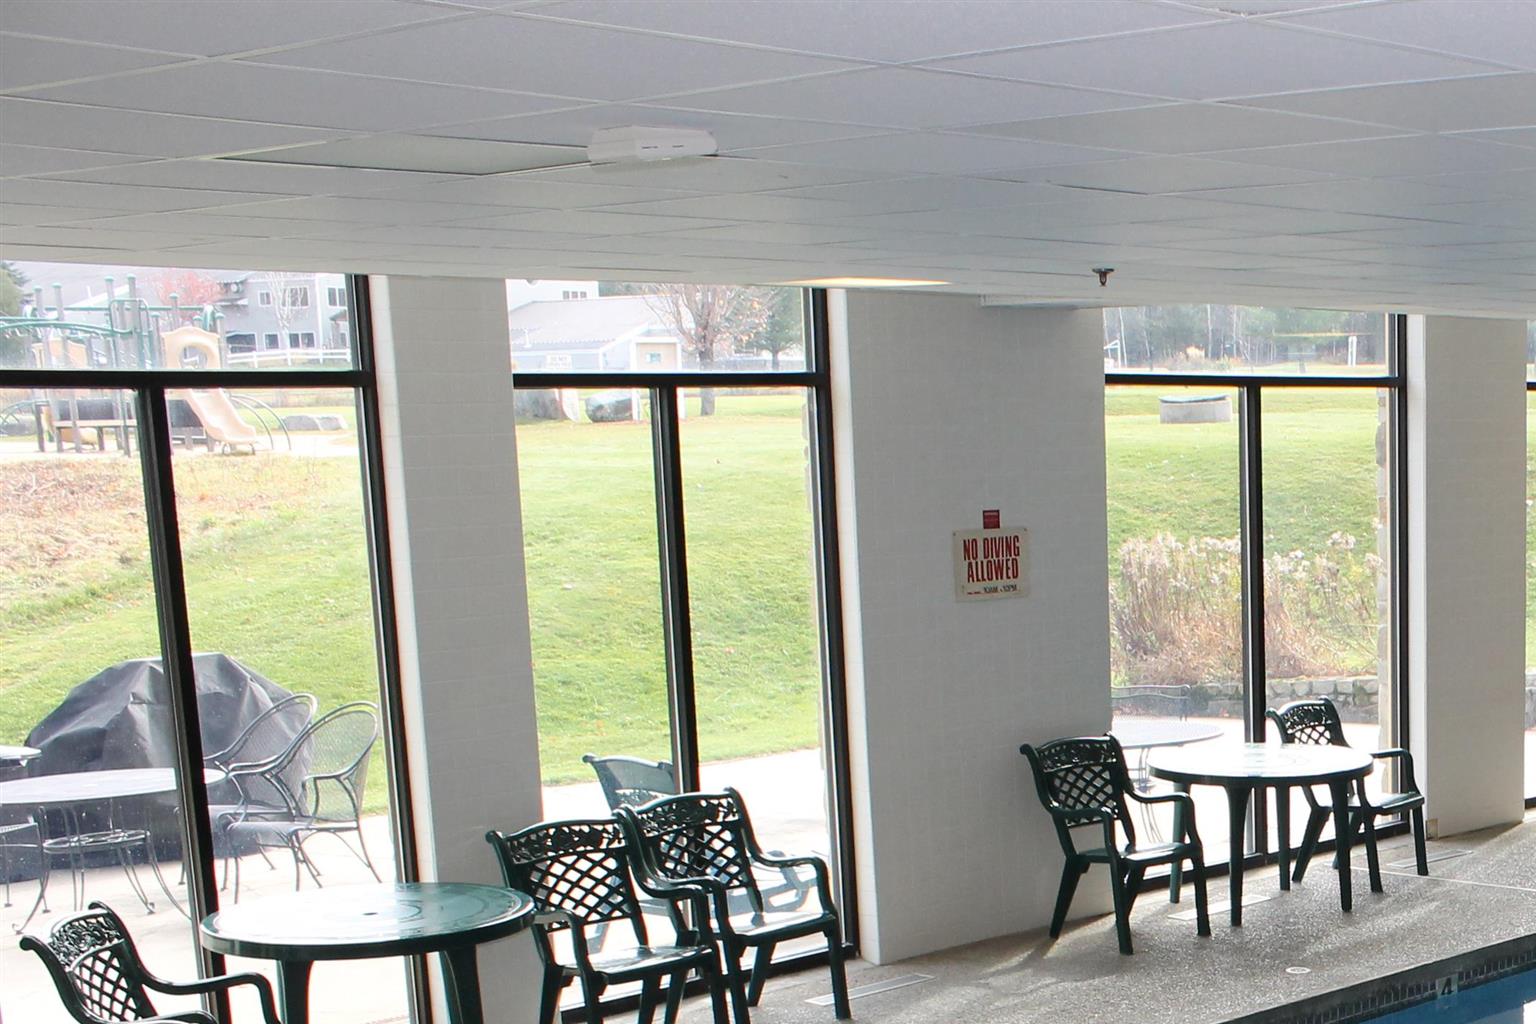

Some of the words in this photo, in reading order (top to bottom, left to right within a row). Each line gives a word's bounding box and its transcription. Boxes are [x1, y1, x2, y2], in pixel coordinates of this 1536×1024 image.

[963, 538, 978, 561] NO
[983, 535, 1020, 559] DIVING
[967, 557, 1019, 583] ALLOWED
